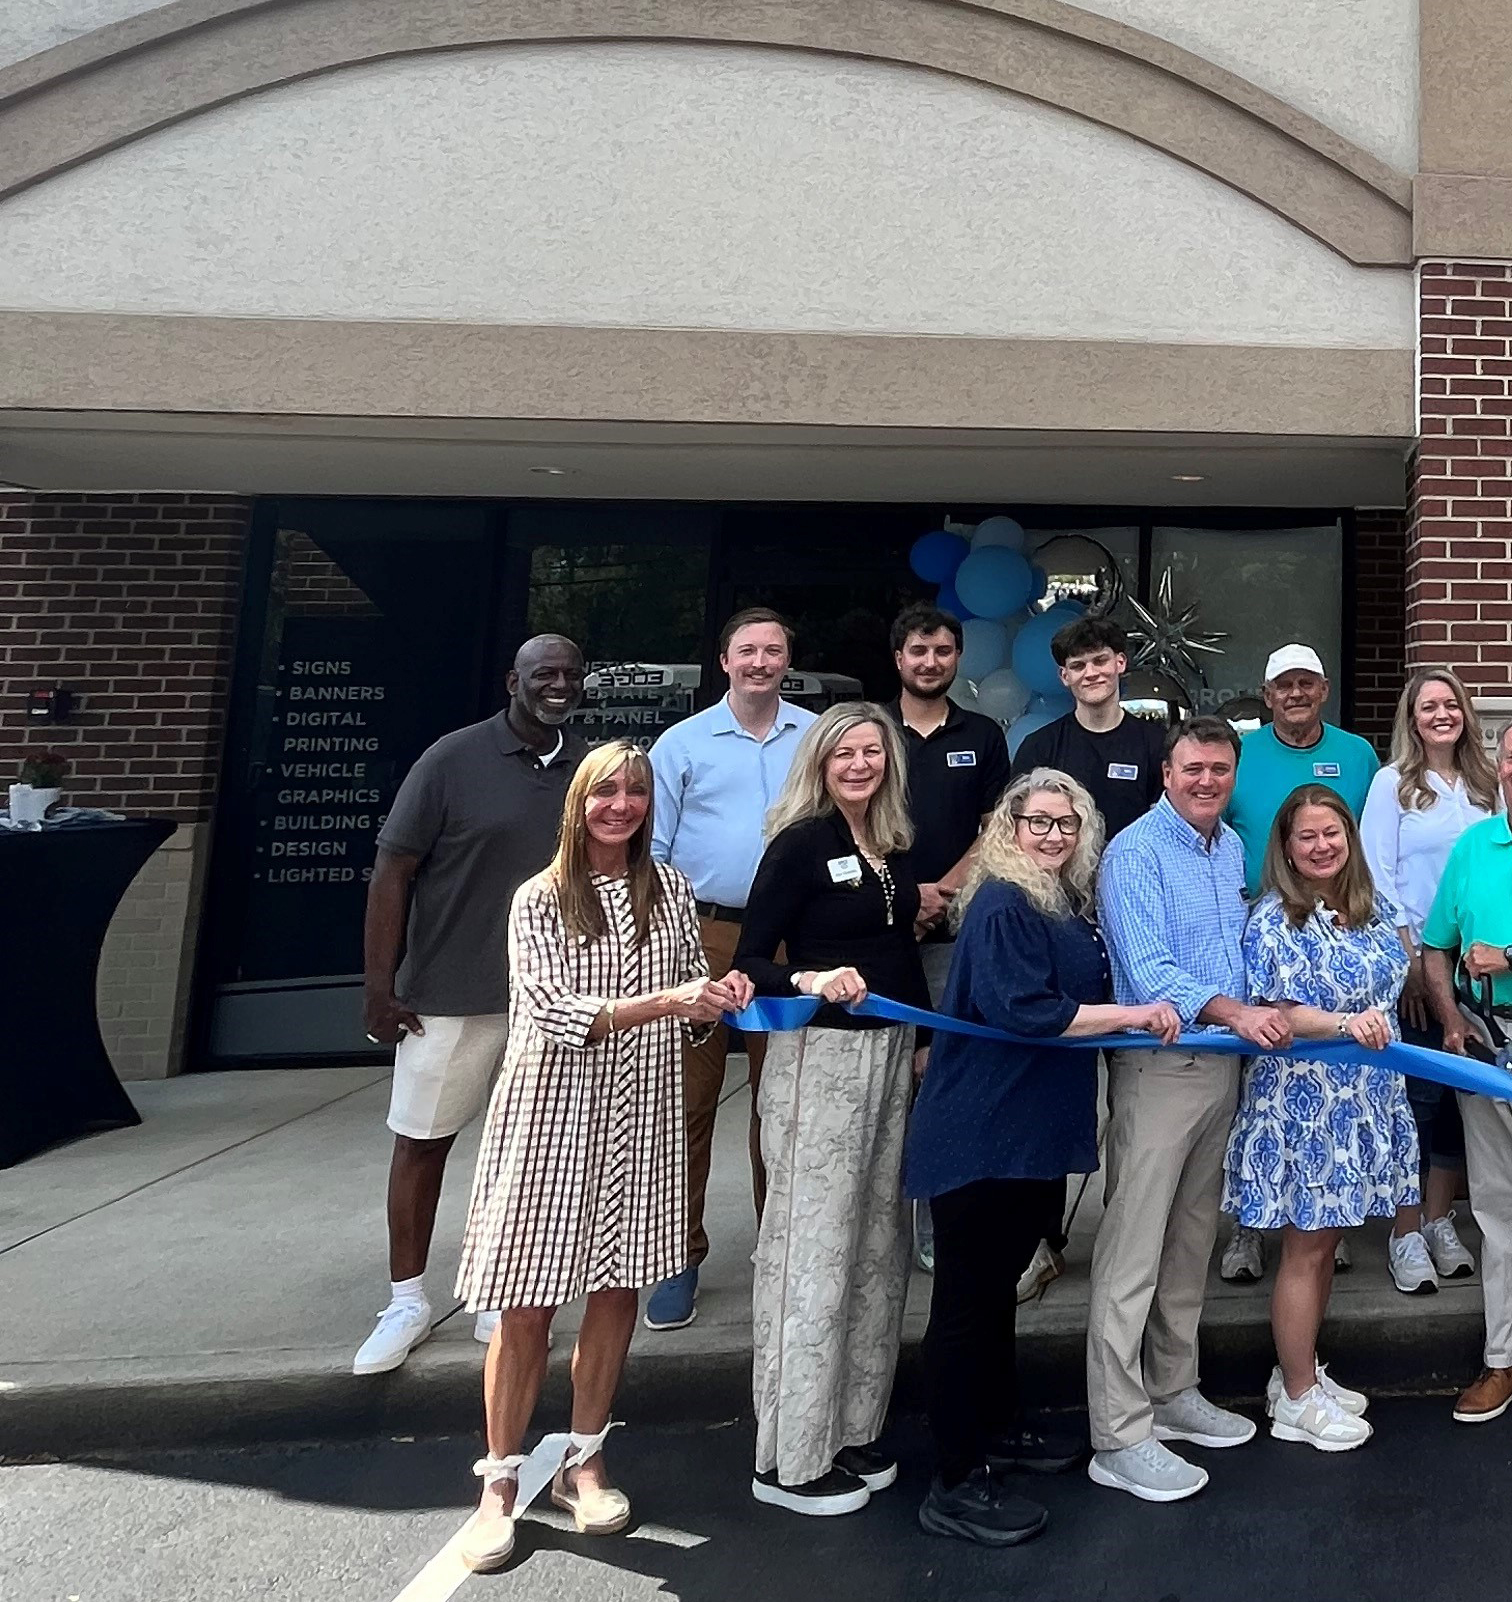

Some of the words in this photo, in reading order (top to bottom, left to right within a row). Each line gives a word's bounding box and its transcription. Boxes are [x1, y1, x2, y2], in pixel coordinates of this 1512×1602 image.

[291, 660, 352, 675] SIGNS
[289, 686, 385, 701] BANNERS
[285, 711, 367, 726] DIGITAL
[602, 711, 665, 725] PANEL
[283, 737, 379, 752] PRINTING
[280, 763, 367, 777] VEHICLE
[277, 788, 380, 804] GRAPHICS
[273, 814, 371, 830] BUILDING
[270, 841, 347, 857] DESIGN
[267, 867, 355, 883] LIGHTED
